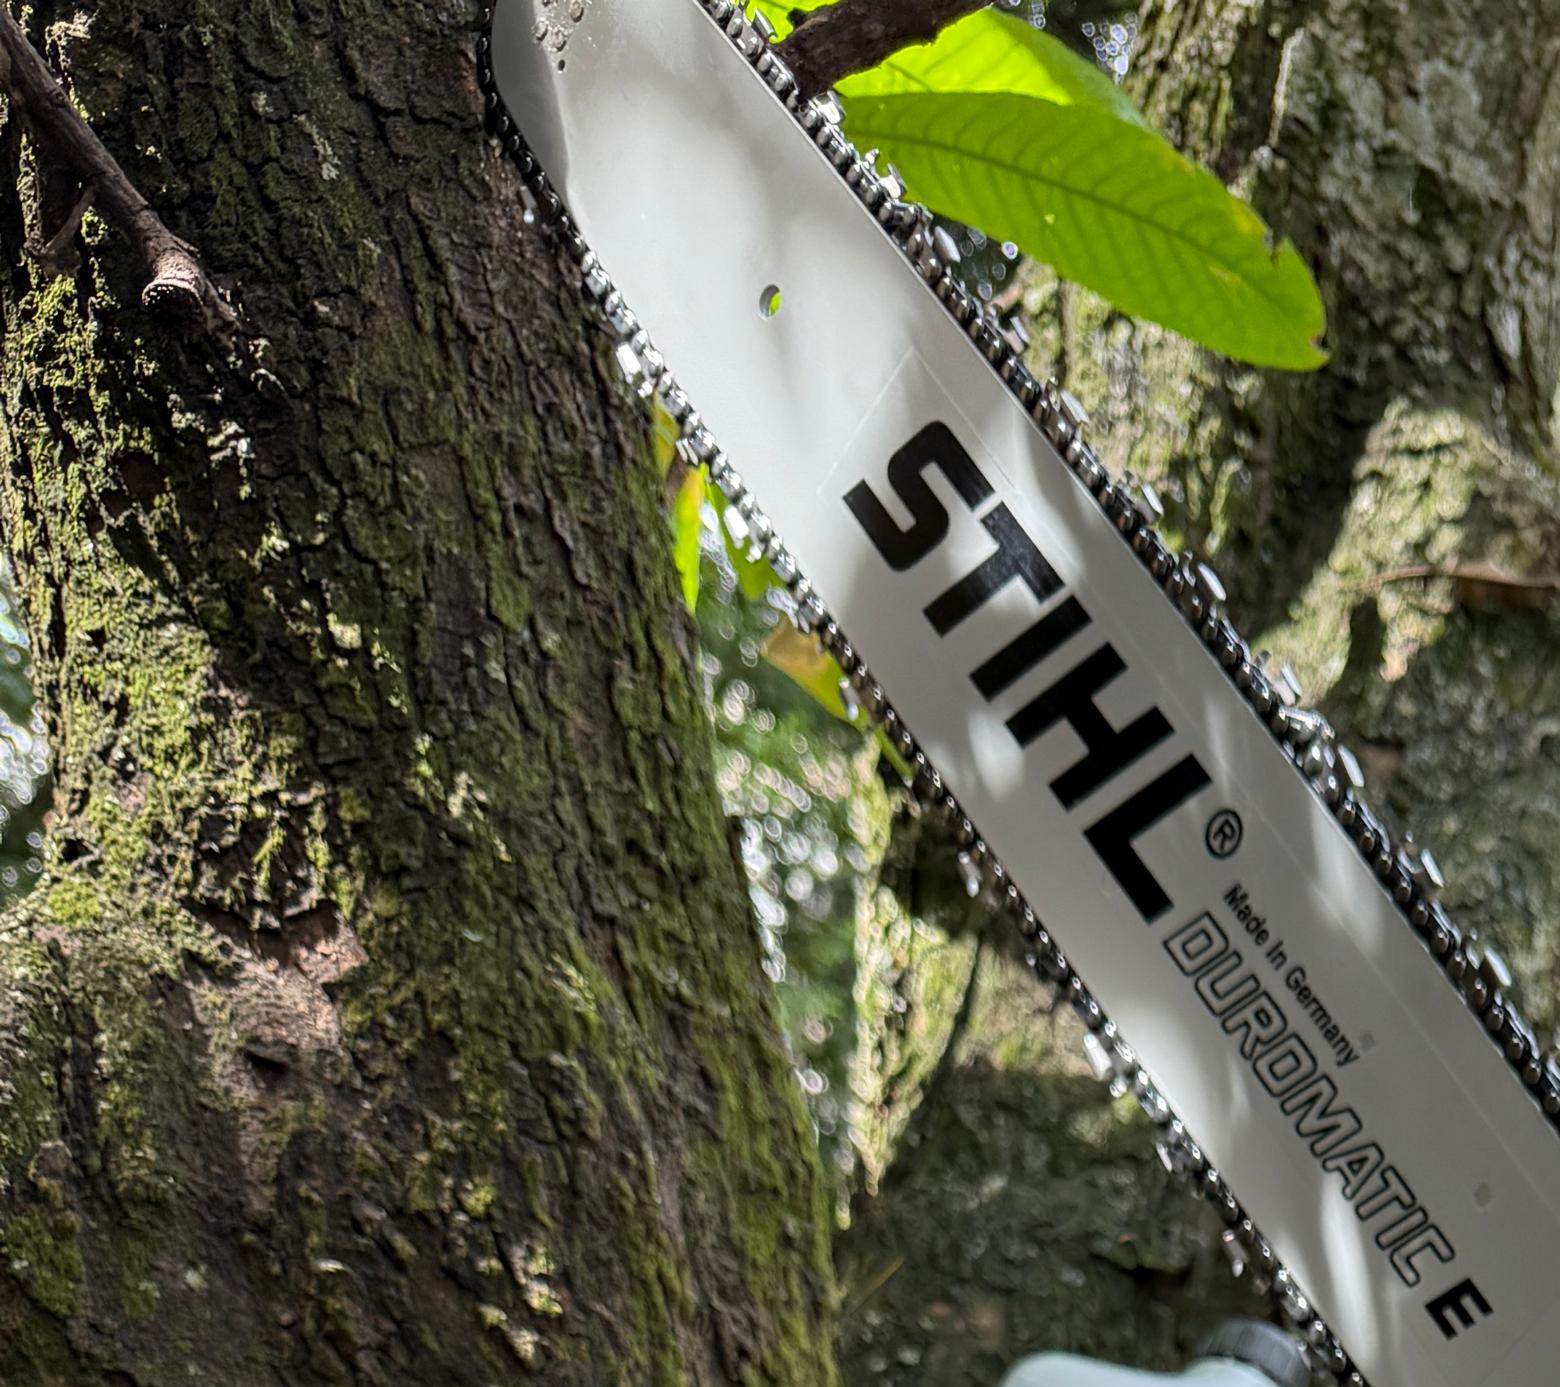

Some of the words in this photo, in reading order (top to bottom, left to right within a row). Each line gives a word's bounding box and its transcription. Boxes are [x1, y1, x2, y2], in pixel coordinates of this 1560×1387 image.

[841, 420, 1213, 924] STIHL
[1160, 914, 1456, 1289] DUROMATIC
[1423, 1274, 1495, 1342] E
[1223, 883, 1270, 947] Made
[1265, 940, 1288, 971] In
[1284, 965, 1360, 1066] Germany
